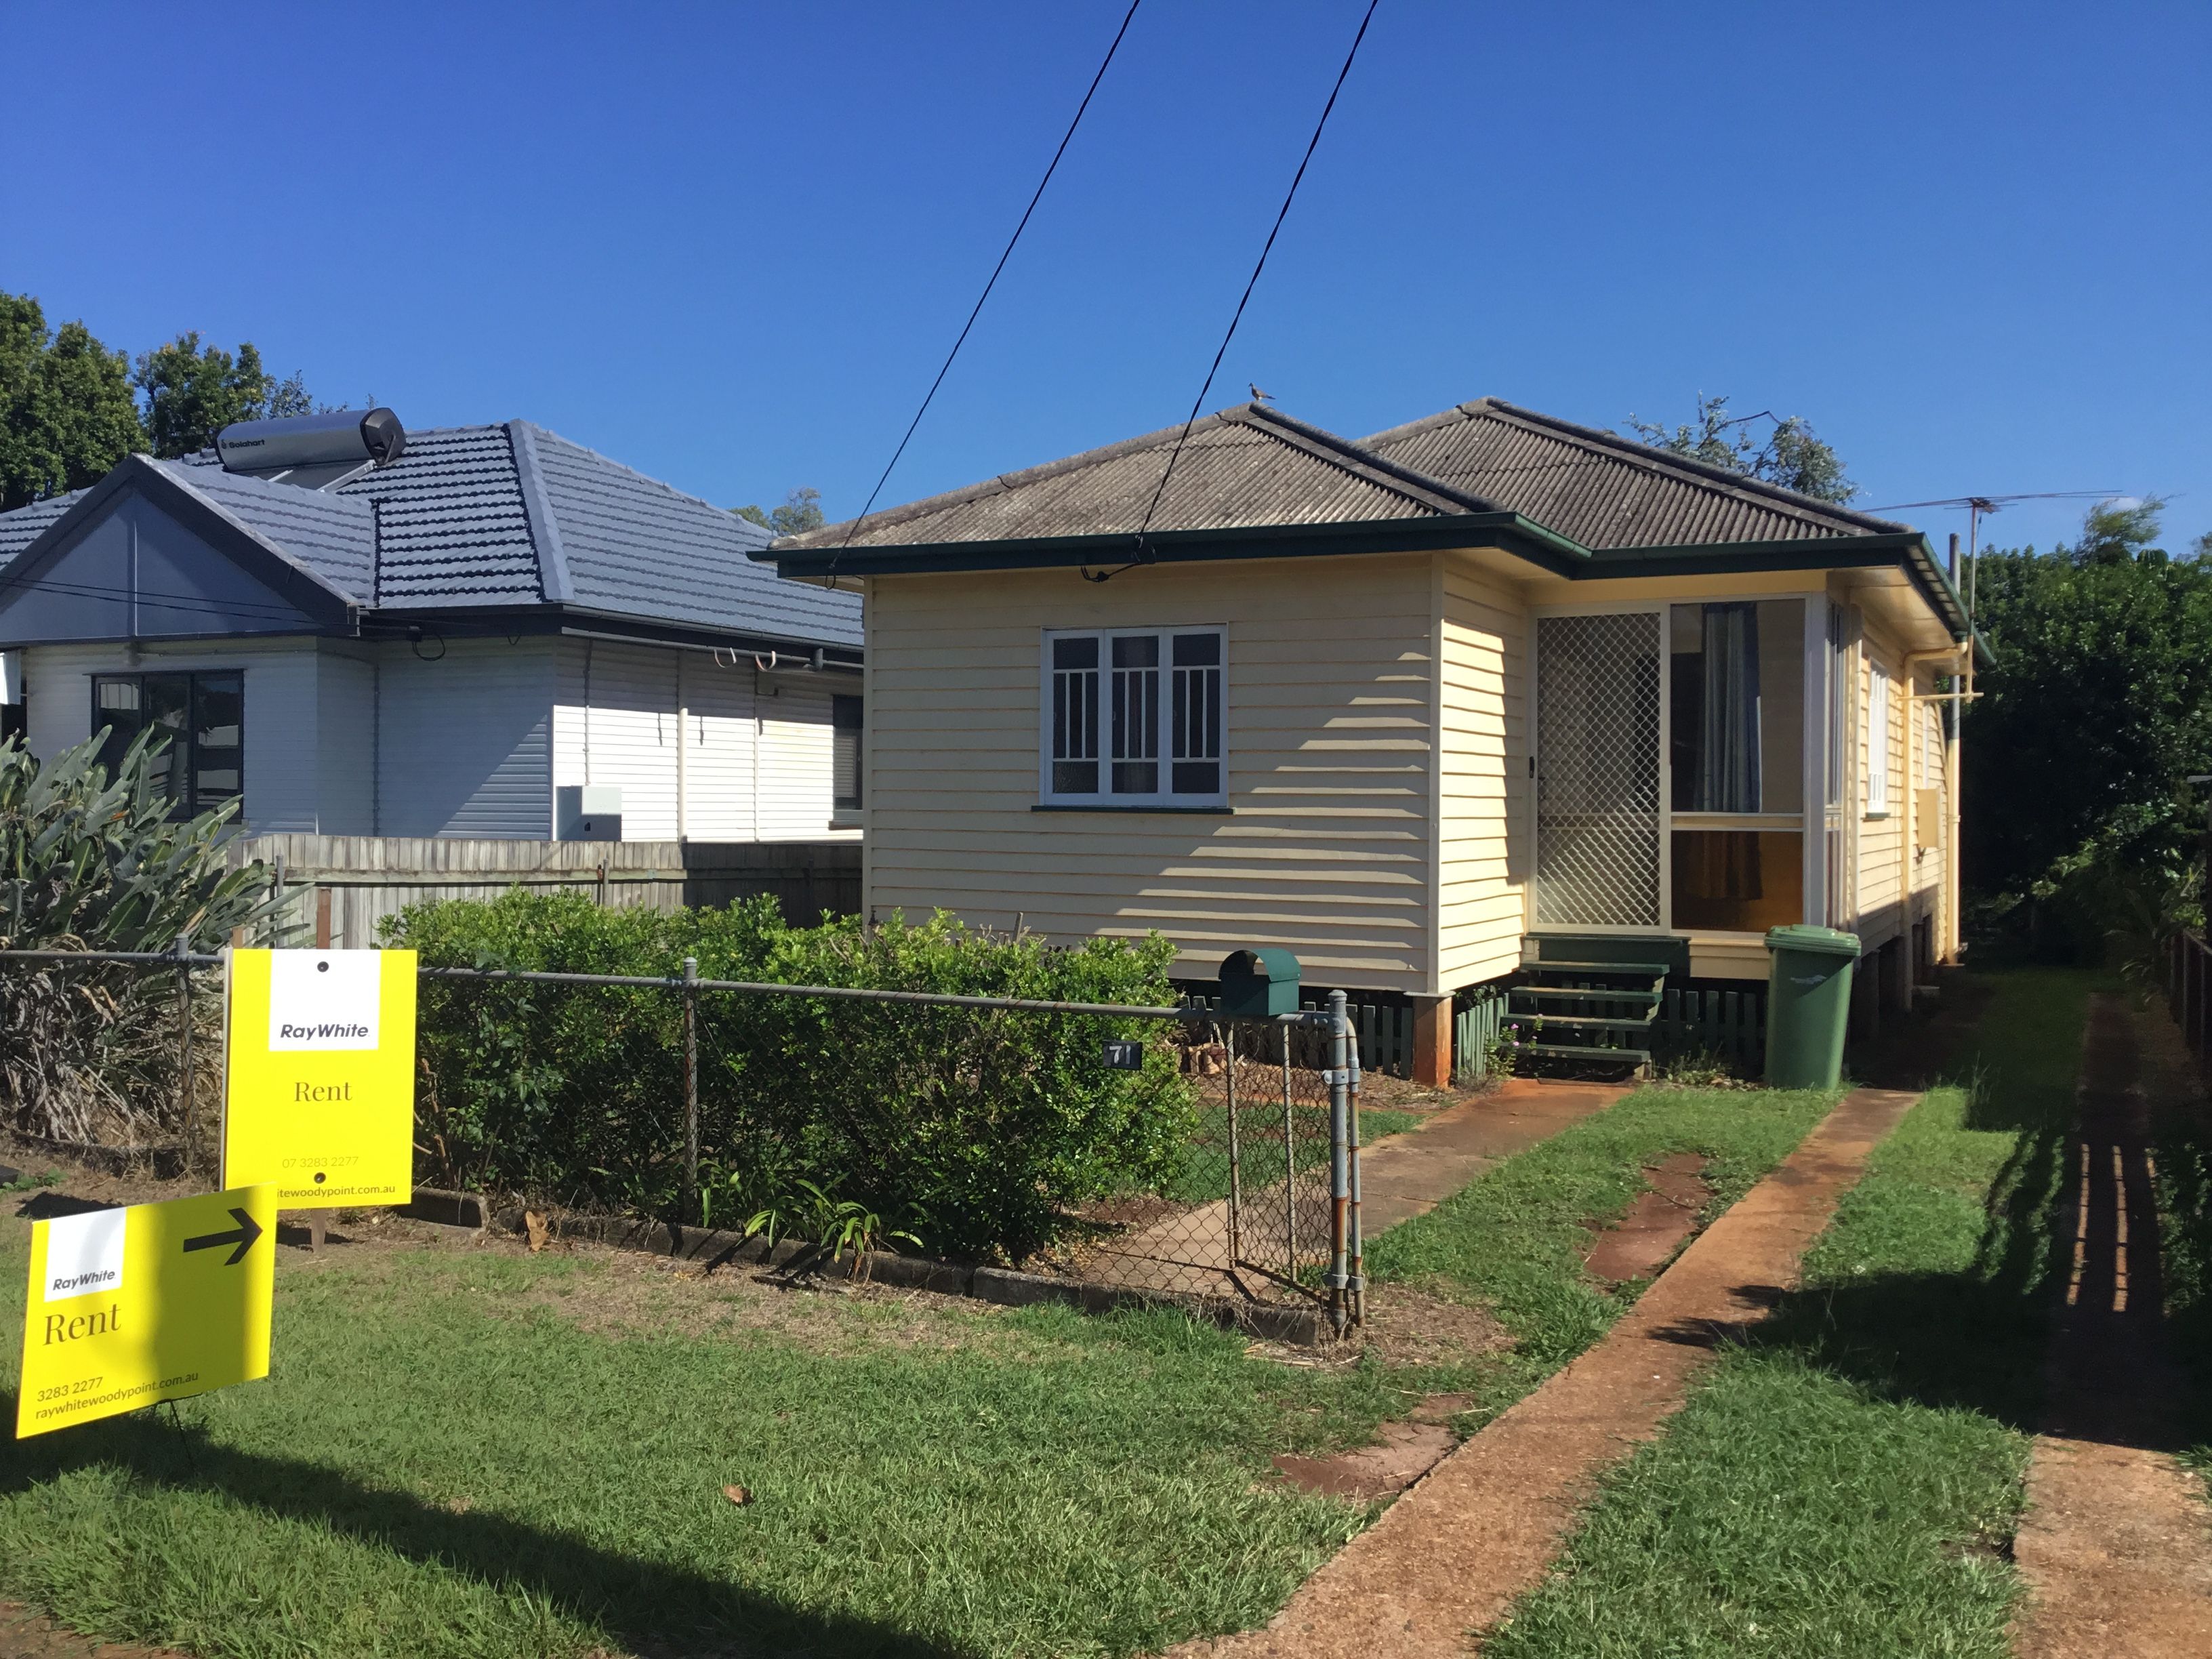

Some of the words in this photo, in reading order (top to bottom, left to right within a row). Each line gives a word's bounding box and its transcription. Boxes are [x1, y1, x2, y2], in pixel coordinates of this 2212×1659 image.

[1109, 1044, 1131, 1065] 71
[293, 1082, 352, 1102] Rent
[282, 1158, 297, 1168] 07
[300, 1158, 328, 1168] 3283
[331, 1156, 359, 1166] 2277
[277, 1185, 396, 1198] itewoodypoint.com.au
[43, 1303, 121, 1346] Rent
[35, 1372, 199, 1420] raywhitewoodypoint.com.au
[37, 1385, 68, 1402] 3283
[73, 1376, 103, 1394] 2277
